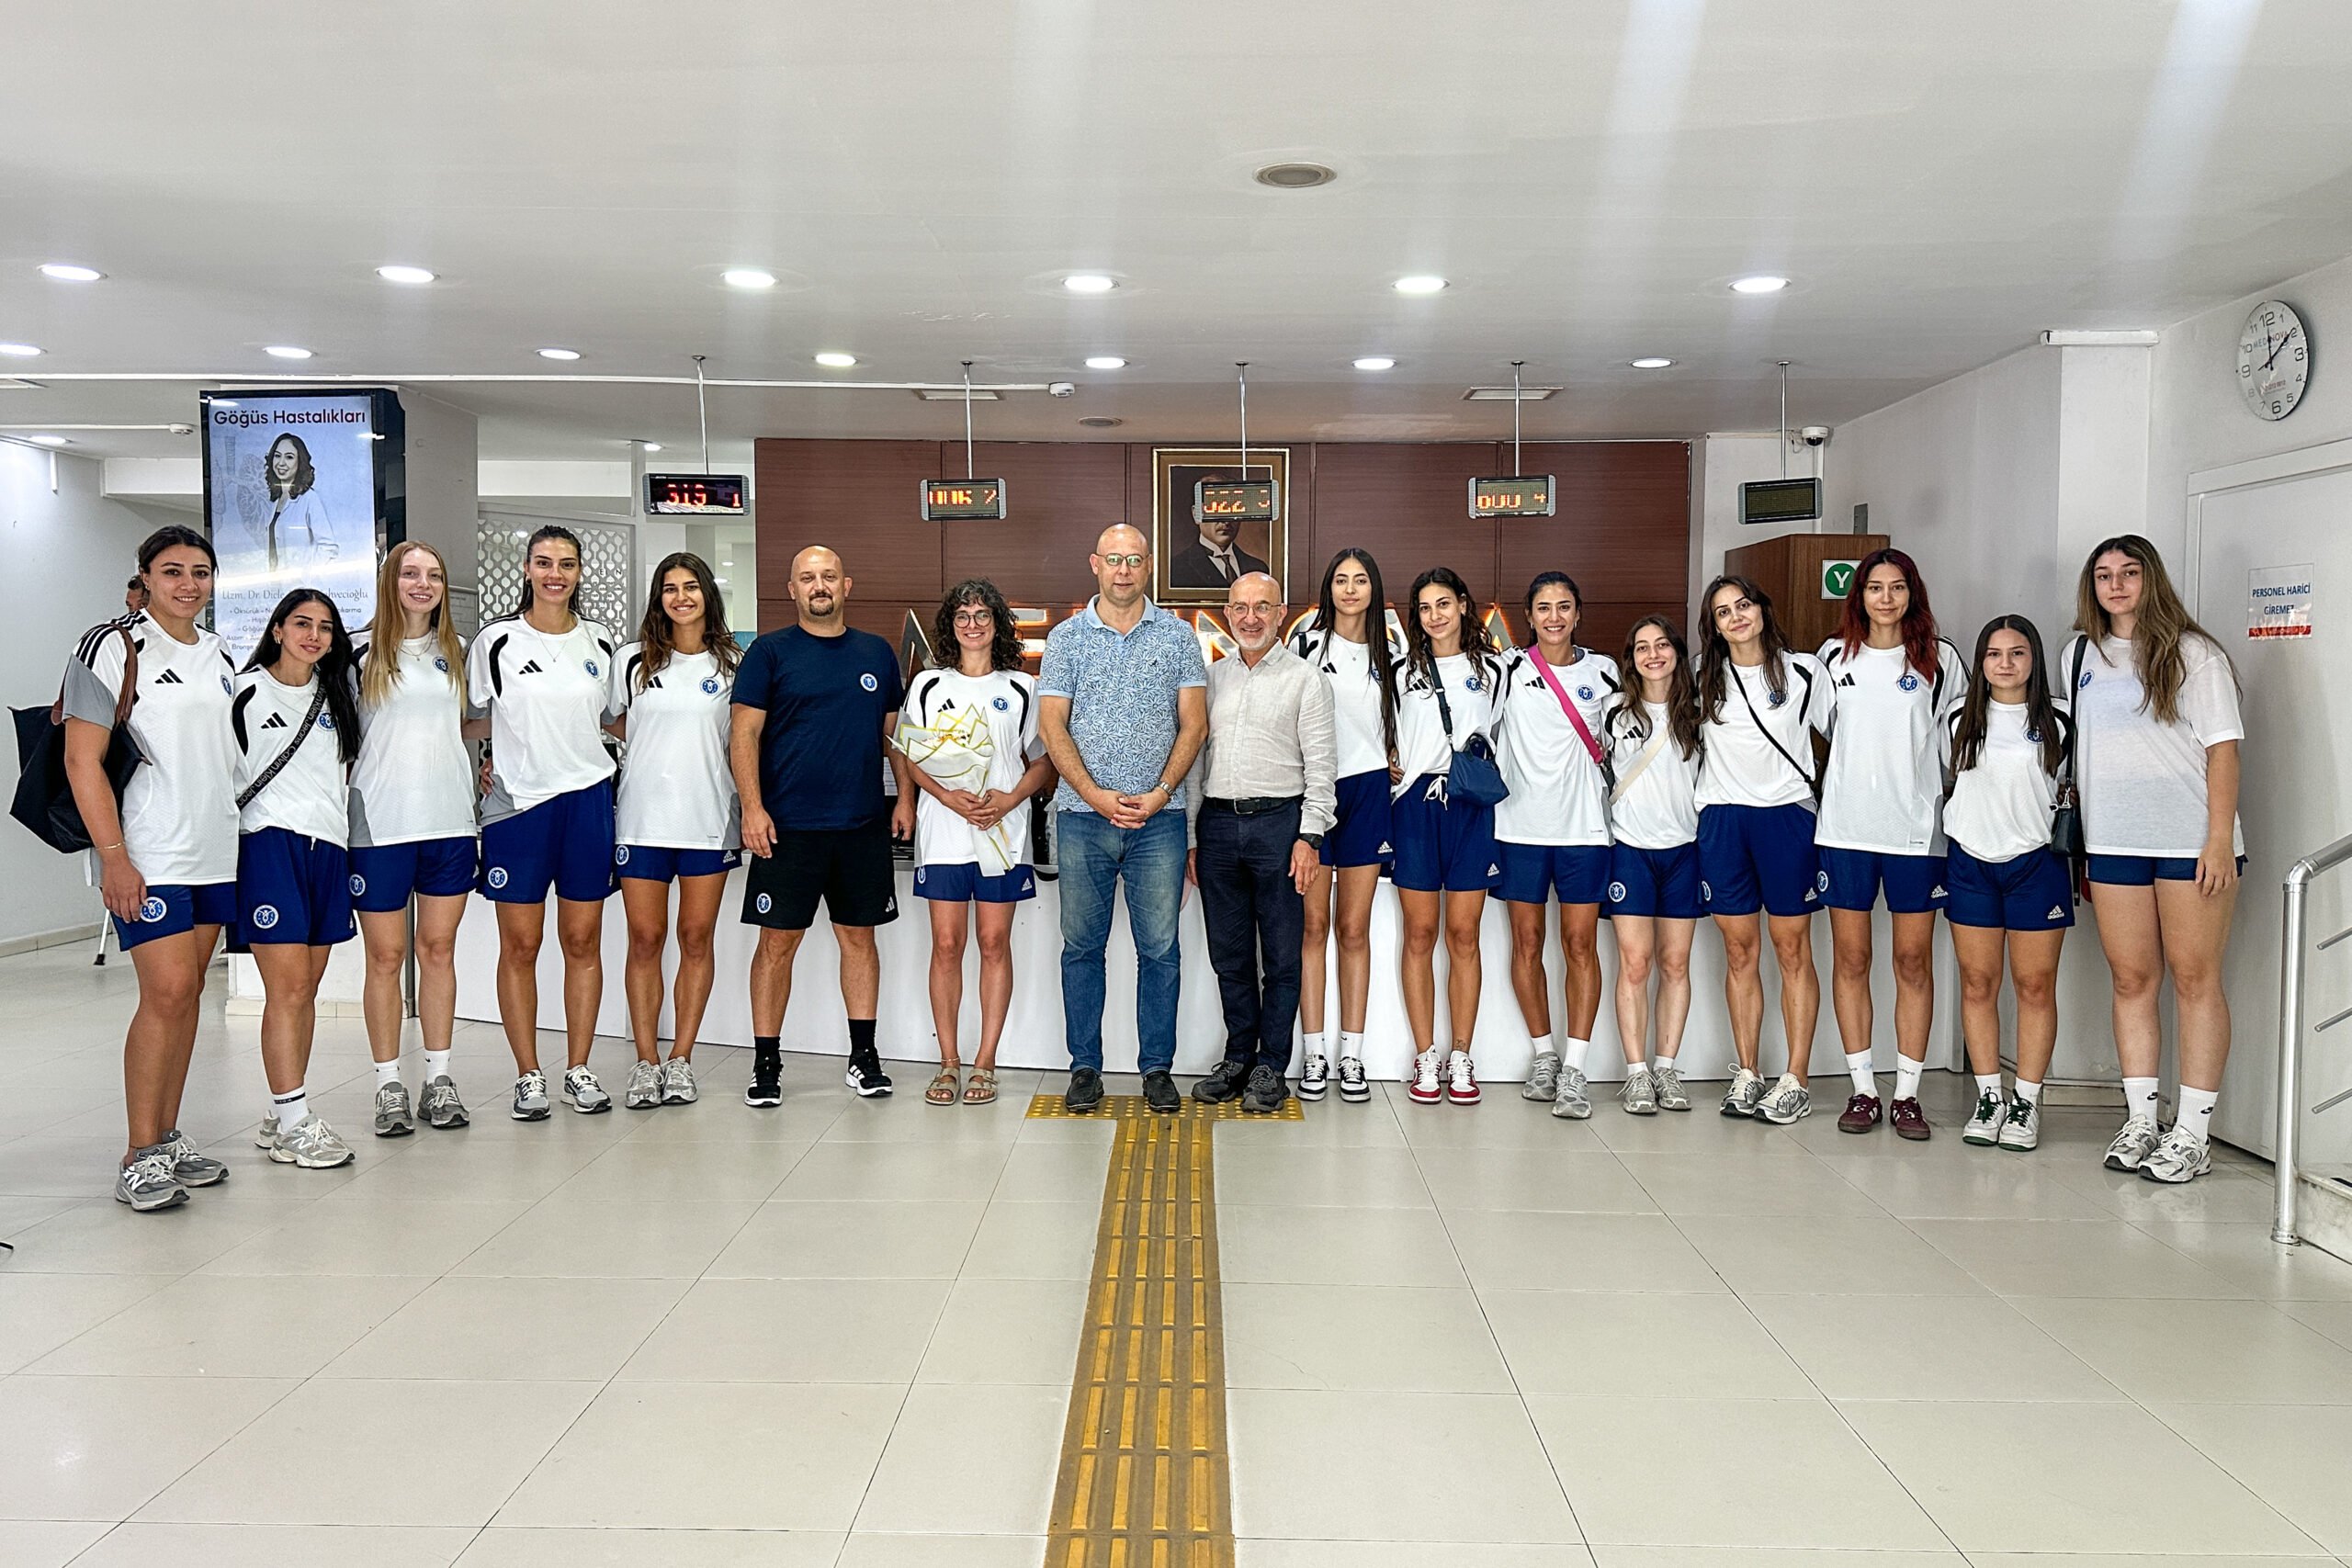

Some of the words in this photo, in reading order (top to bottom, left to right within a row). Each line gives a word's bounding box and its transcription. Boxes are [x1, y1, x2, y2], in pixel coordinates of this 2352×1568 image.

[2259, 311, 2275, 326] 12
[2294, 347, 2304, 361] 3
[2242, 365, 2251, 378] 9
[2295, 374, 2302, 382] 4
[2248, 389, 2255, 398] 8
[2287, 393, 2294, 403] 5
[2271, 400, 2281, 414] 6
[214, 410, 268, 428] Göğüs
[274, 408, 366, 424] Hastalıkları
[1834, 570, 1850, 589] Y
[222, 590, 245, 600] Uzm.
[248, 590, 260, 600] Dr.
[2253, 586, 2285, 597] PERSONEL
[2287, 582, 2311, 595] HARİCİ
[308, 702, 322, 718] Klein
[294, 720, 311, 745] Jeans
[271, 746, 296, 771] Calvin
[254, 768, 275, 788] Klein
[237, 786, 257, 806] Jean
